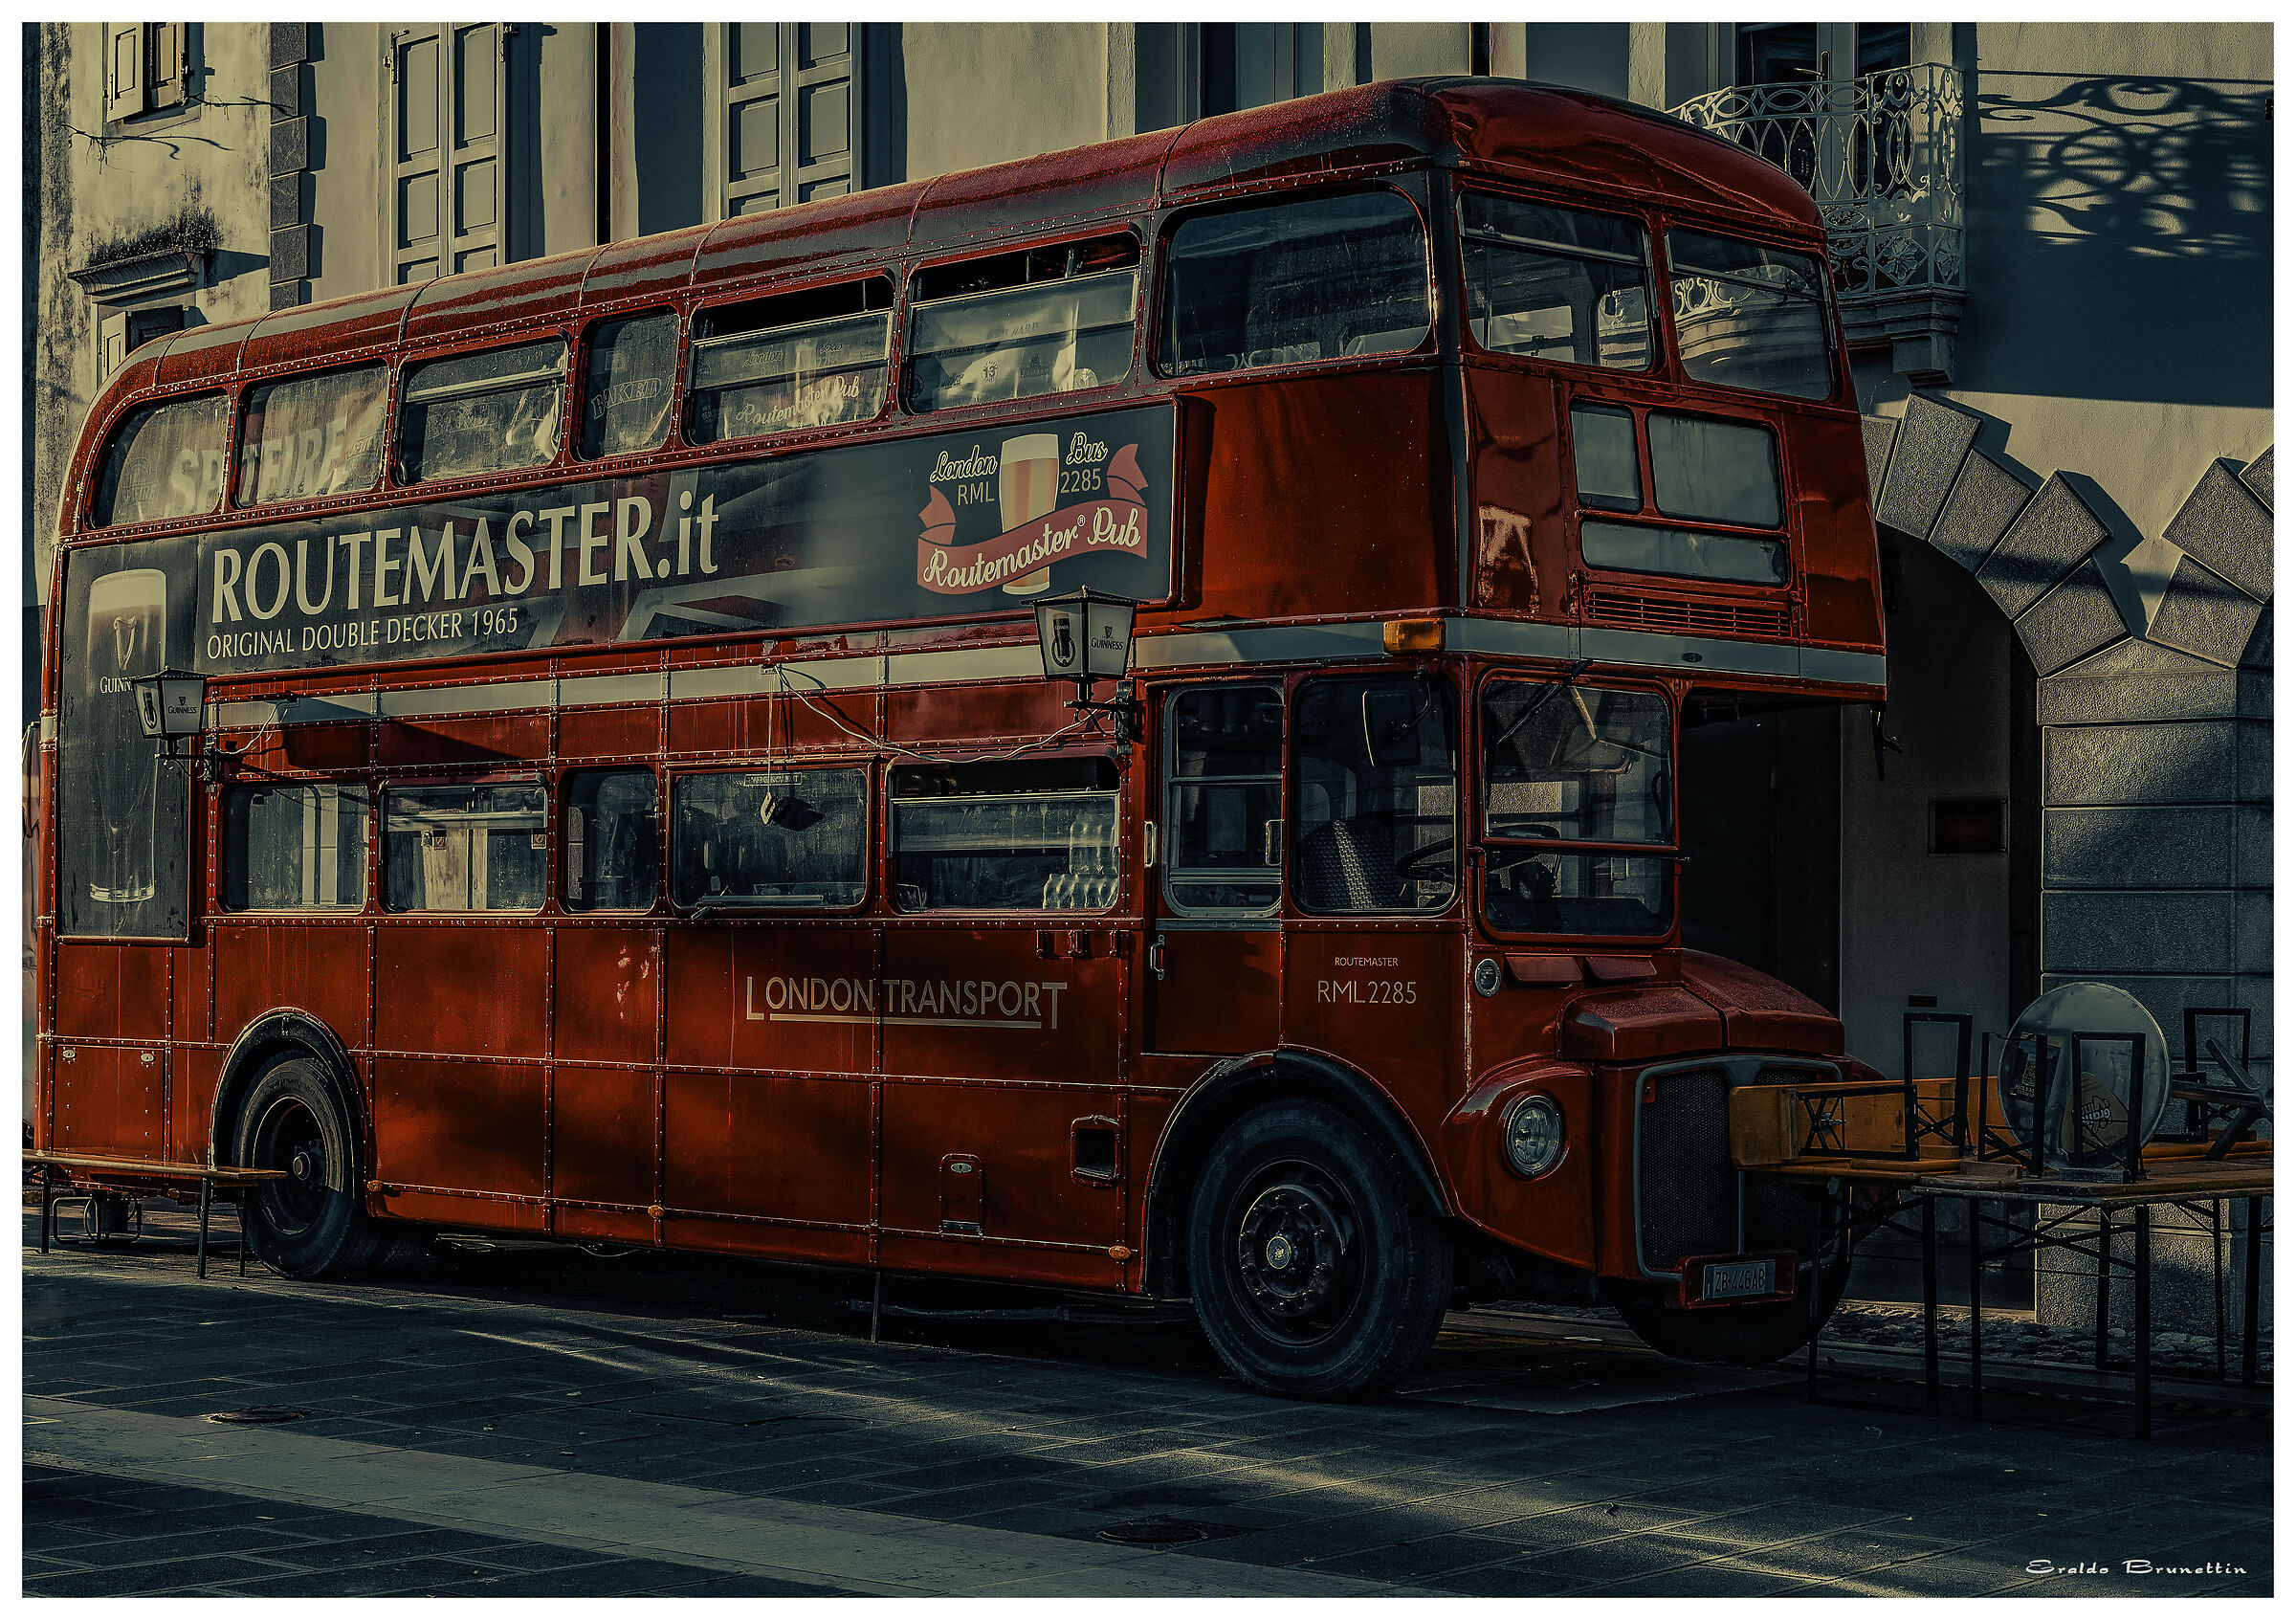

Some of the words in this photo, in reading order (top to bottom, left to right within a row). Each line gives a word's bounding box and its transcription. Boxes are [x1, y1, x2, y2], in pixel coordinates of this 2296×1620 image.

[929, 444, 999, 483] London
[1066, 432, 1109, 465] Bus
[958, 481, 996, 506] RML
[1060, 468, 1102, 494] 2285
[1087, 506, 1141, 548] Pub
[211, 490, 720, 624] ROUTEMASTER.it
[207, 628, 295, 660] ORIGINAL
[301, 620, 380, 652] DOUBLE
[386, 610, 463, 643] DECKER
[472, 607, 519, 636] 1965
[1092, 637, 1124, 651] GUINNESS
[99, 676, 133, 694] GUINN
[167, 705, 197, 715] GUINNESS
[1335, 957, 1399, 966] ROUTEMASTER
[746, 976, 873, 1021] LONDON
[882, 979, 1068, 1030] TRANSPORT
